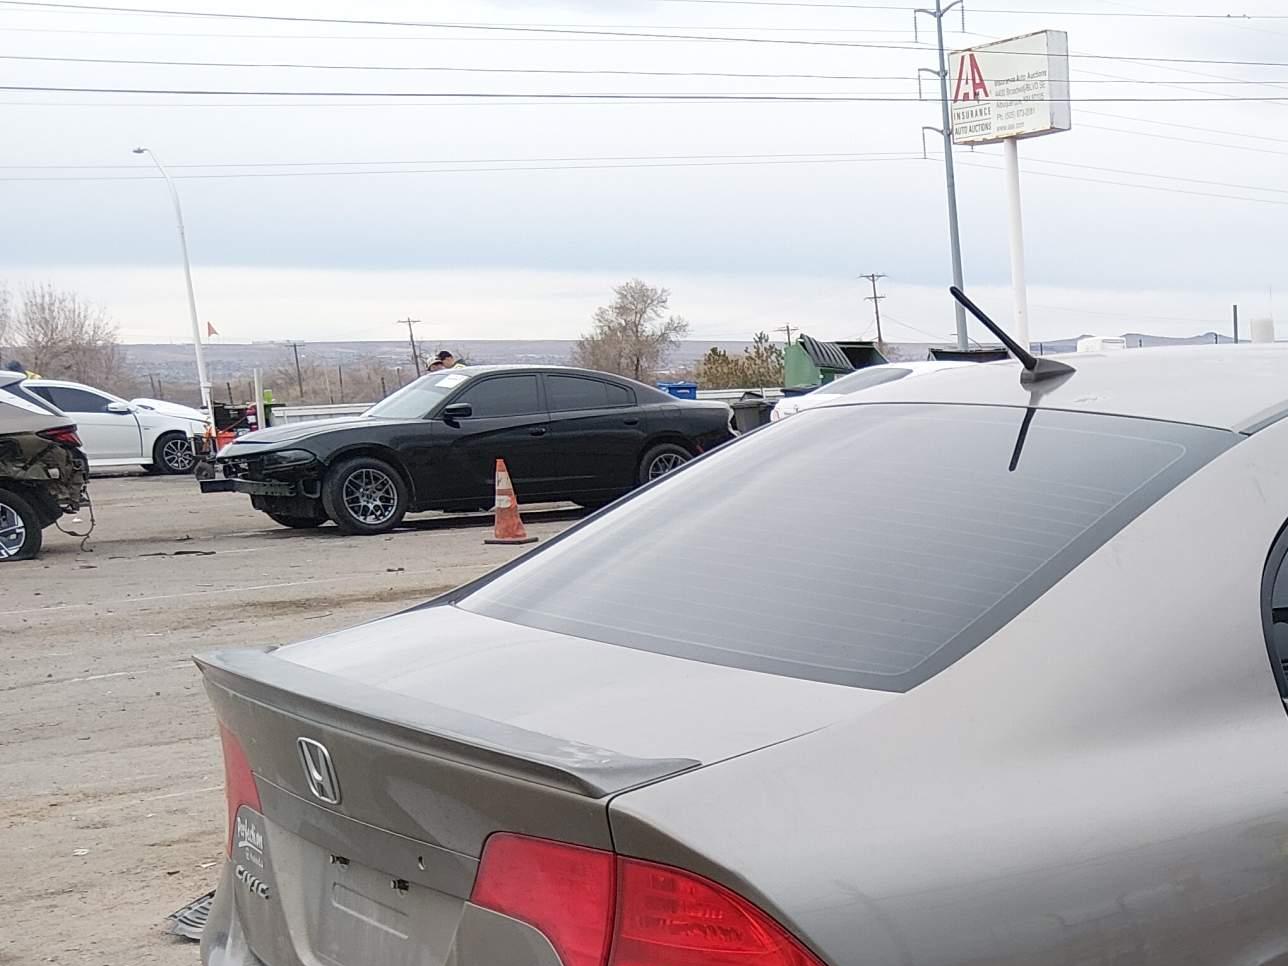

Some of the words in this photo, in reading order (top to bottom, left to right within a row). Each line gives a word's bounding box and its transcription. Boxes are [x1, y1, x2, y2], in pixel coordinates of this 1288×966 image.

[953, 106, 991, 121] INSURANCE
[955, 125, 968, 136] AUTO
[968, 121, 992, 133] AUCTIONS
[235, 865, 270, 899] CIVIC
